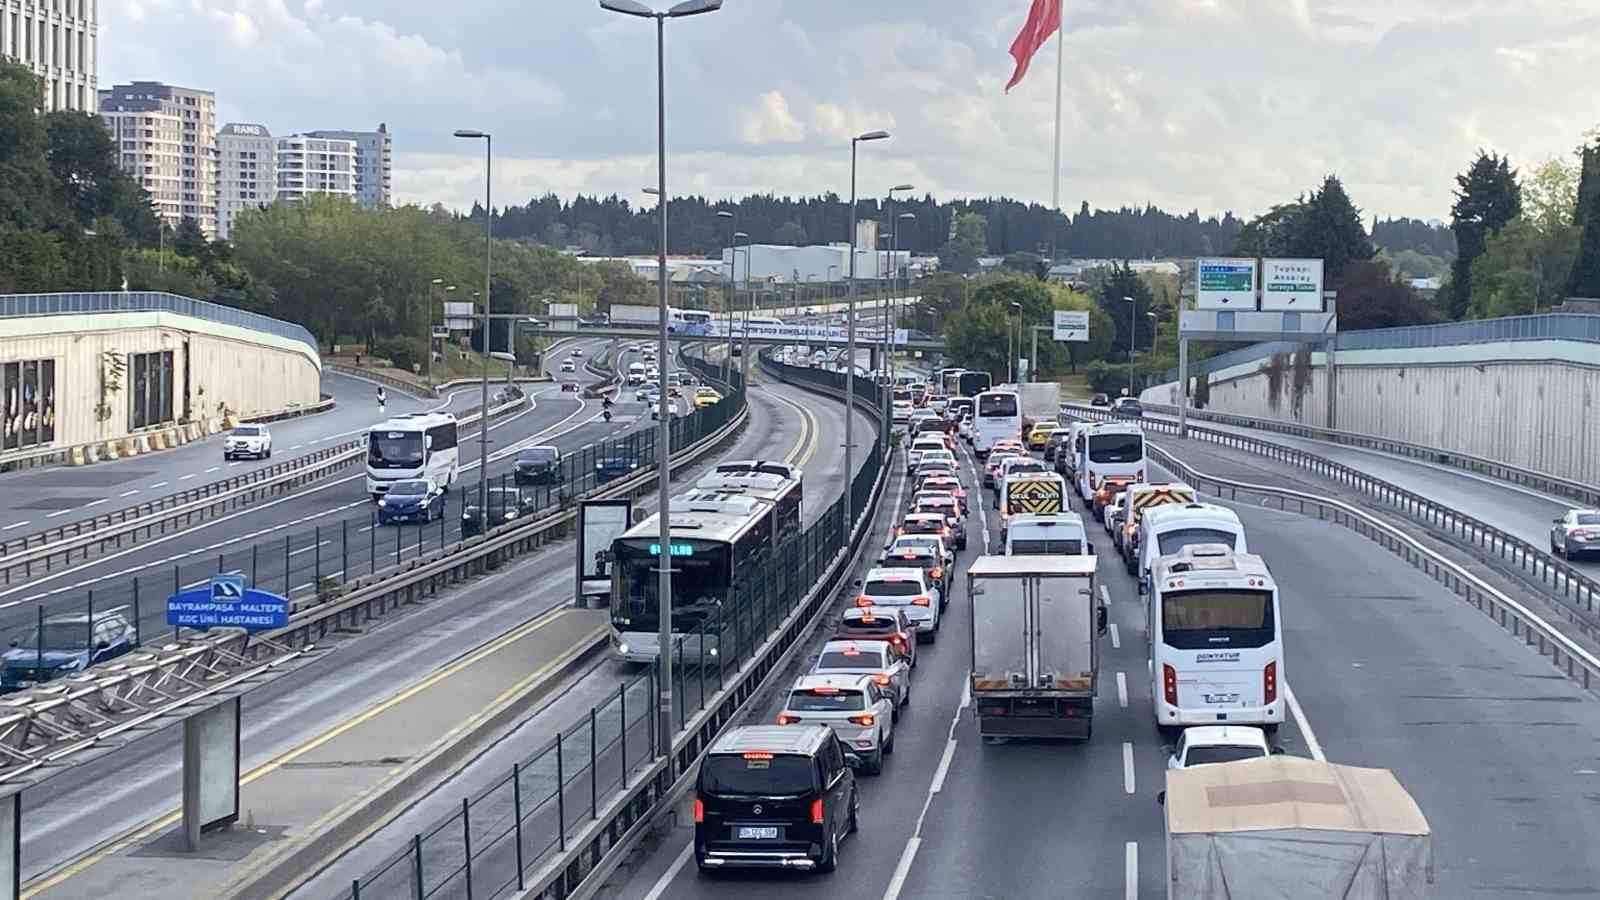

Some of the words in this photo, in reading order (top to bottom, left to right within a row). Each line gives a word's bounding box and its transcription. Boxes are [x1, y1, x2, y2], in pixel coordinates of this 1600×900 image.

[240, 604, 285, 613] MALTEPE
[178, 615, 198, 625] KOÇ
[221, 615, 274, 625] HASTANESİ
